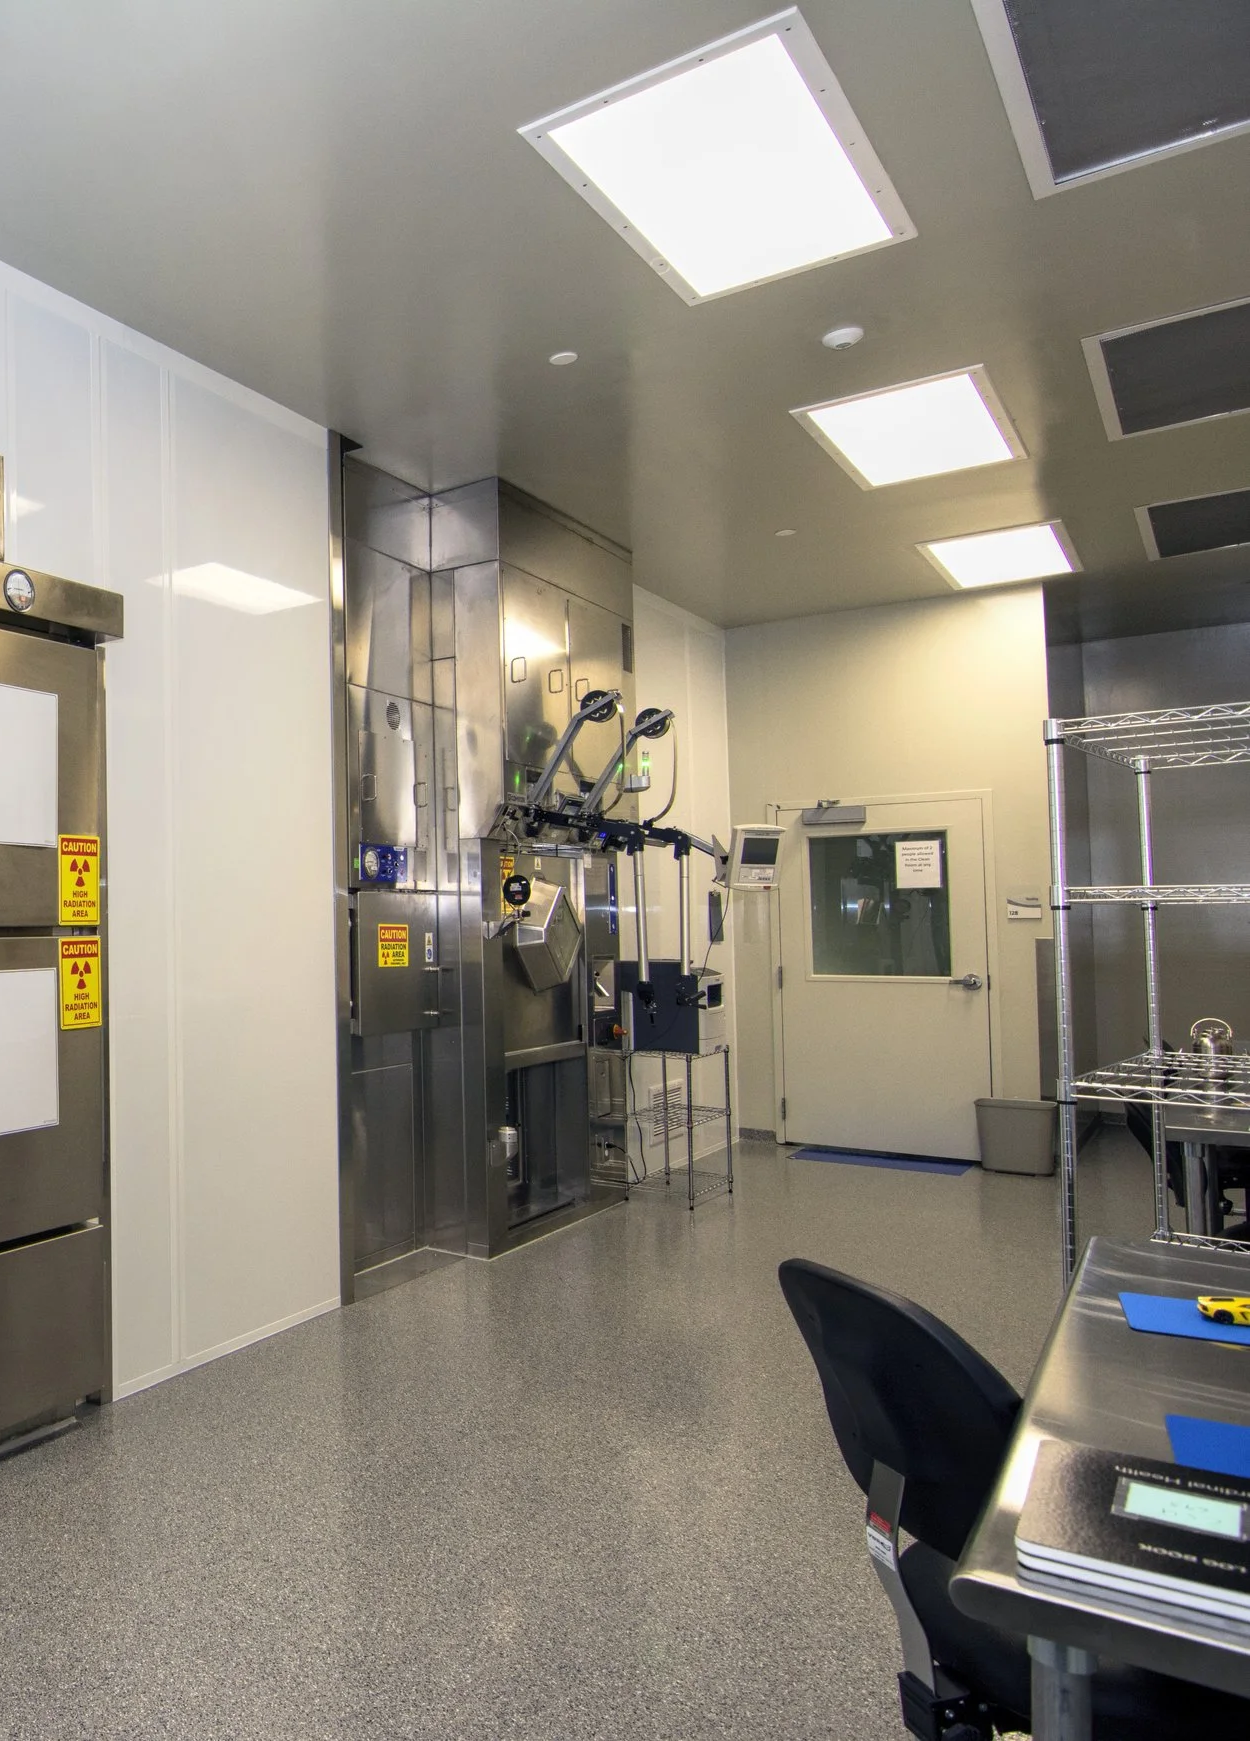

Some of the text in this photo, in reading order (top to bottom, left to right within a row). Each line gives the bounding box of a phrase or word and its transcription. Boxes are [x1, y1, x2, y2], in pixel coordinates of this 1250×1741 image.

[62, 841, 96, 853] CAUTION
[63, 900, 96, 908] RADIATION
[380, 930, 406, 939] CAUTION
[63, 944, 98, 955] CAUTION
[65, 1002, 98, 1011] RADIATION
[74, 1012, 90, 1020] AREA
[1138, 1542, 1247, 1574] LOG BOOK
